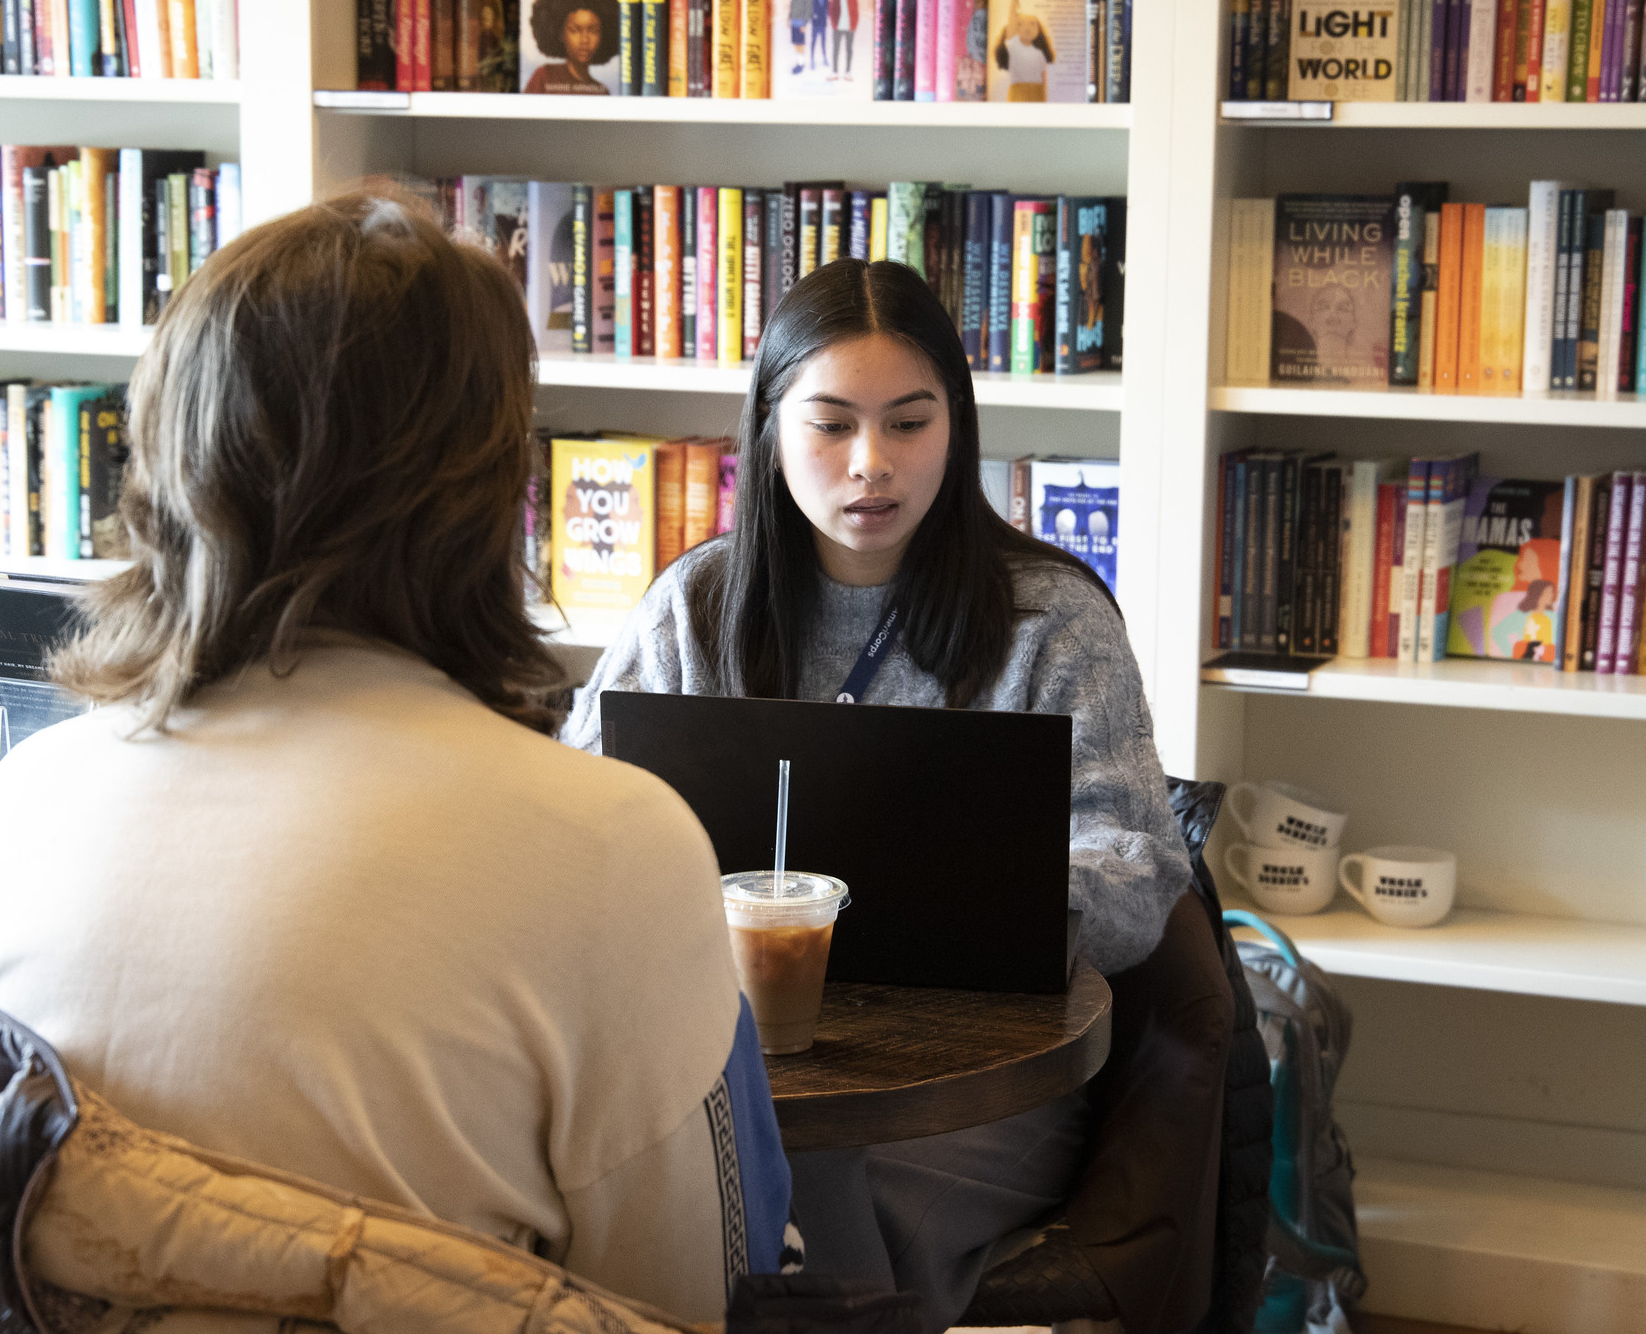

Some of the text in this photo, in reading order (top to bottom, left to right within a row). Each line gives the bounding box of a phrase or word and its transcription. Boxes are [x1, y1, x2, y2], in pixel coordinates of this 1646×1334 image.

[1298, 58, 1393, 80] WORLD
[782, 196, 795, 231] ZERO
[1396, 195, 1411, 241] open
[1289, 222, 1382, 242] LIVING
[1292, 246, 1377, 265] WHILE
[1288, 269, 1379, 288] BLACK
[1396, 248, 1410, 299] rachel
[998, 270, 1009, 330] DESERVE
[572, 457, 634, 484] HOW
[576, 488, 629, 516] YOU
[566, 517, 641, 545] GROW
[1461, 516, 1533, 546] MAMAS
[563, 548, 642, 577] WINGS
